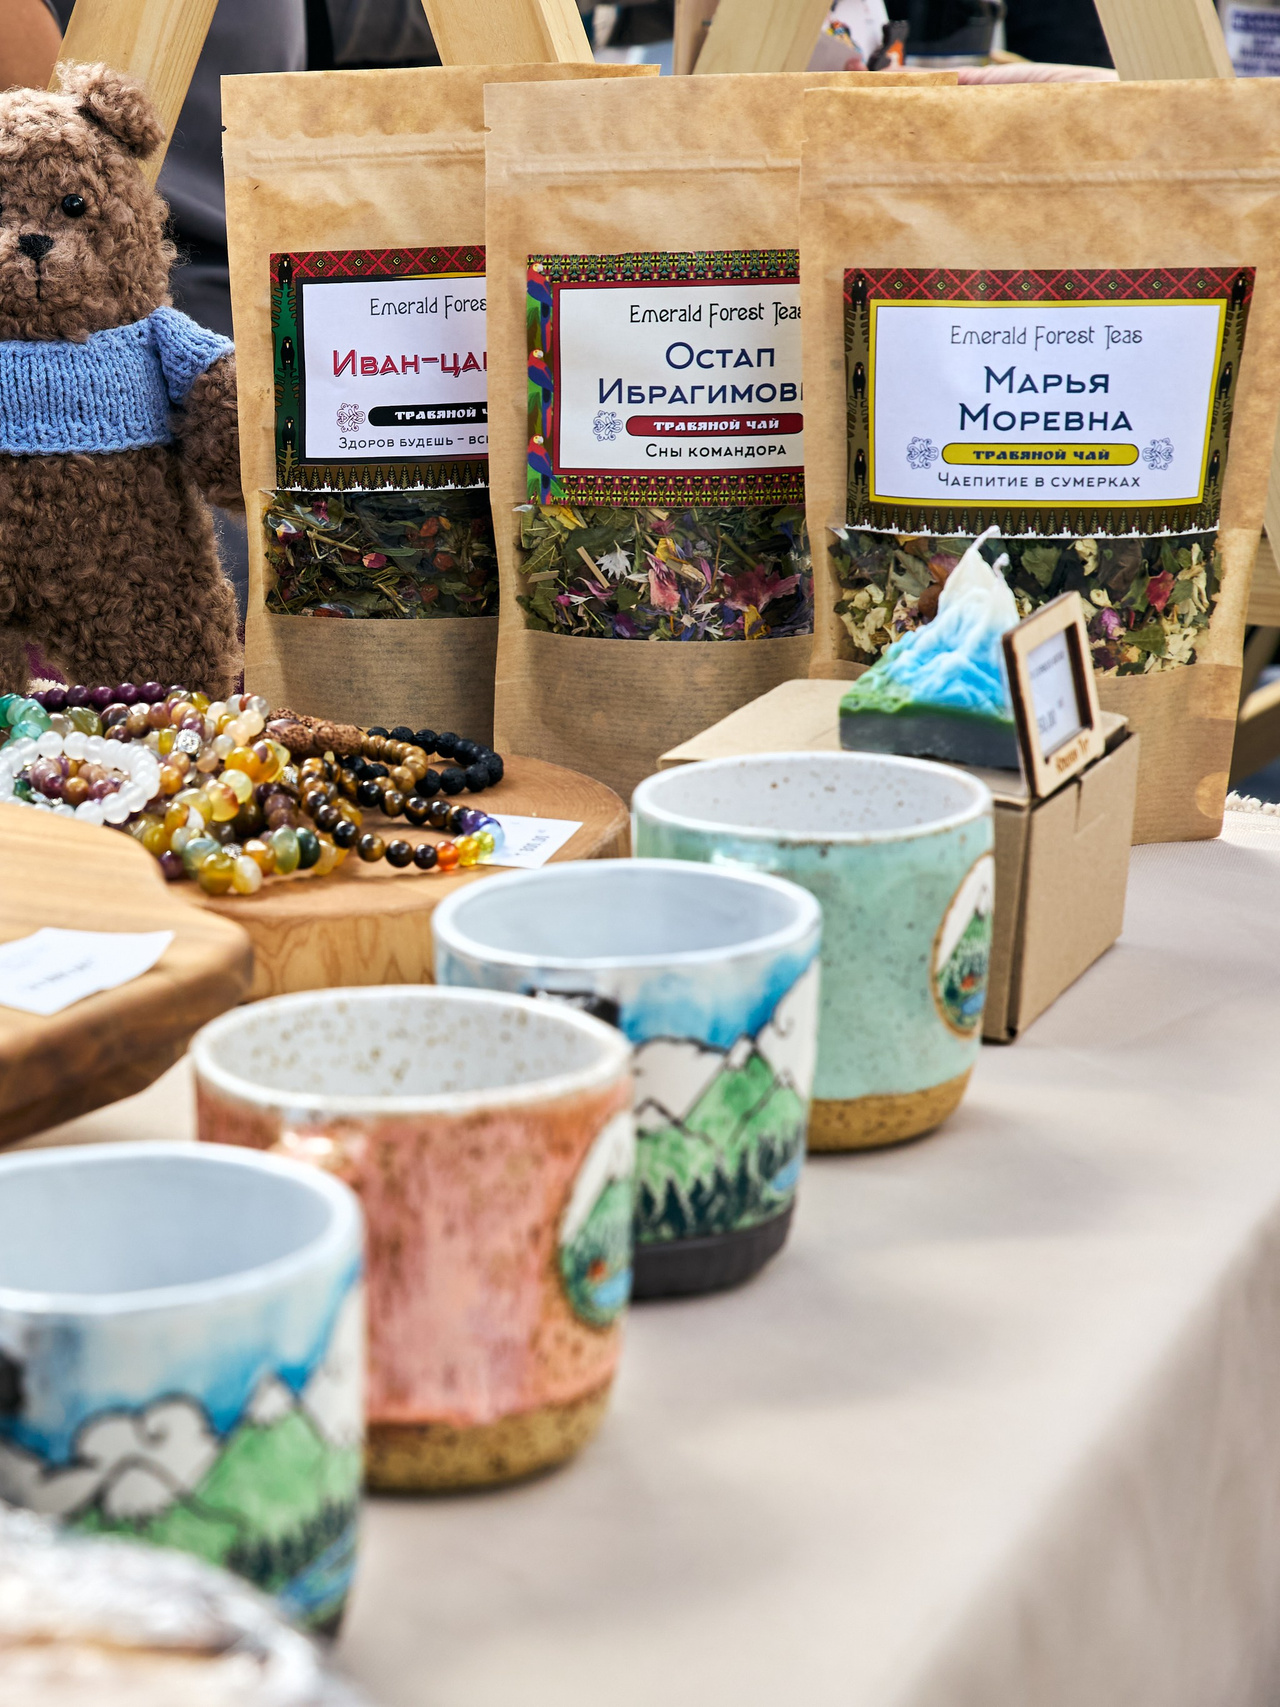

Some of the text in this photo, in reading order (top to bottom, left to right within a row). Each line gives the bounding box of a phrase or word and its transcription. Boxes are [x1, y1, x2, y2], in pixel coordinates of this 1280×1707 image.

[370, 295, 487, 319] Emerald Fores
[630, 304, 702, 323] Emerald
[709, 303, 765, 328] Forest
[950, 325, 1143, 351] Emerald Forest Teas
[333, 350, 487, 378] Иван-ца
[599, 378, 803, 404] Ибрагимов
